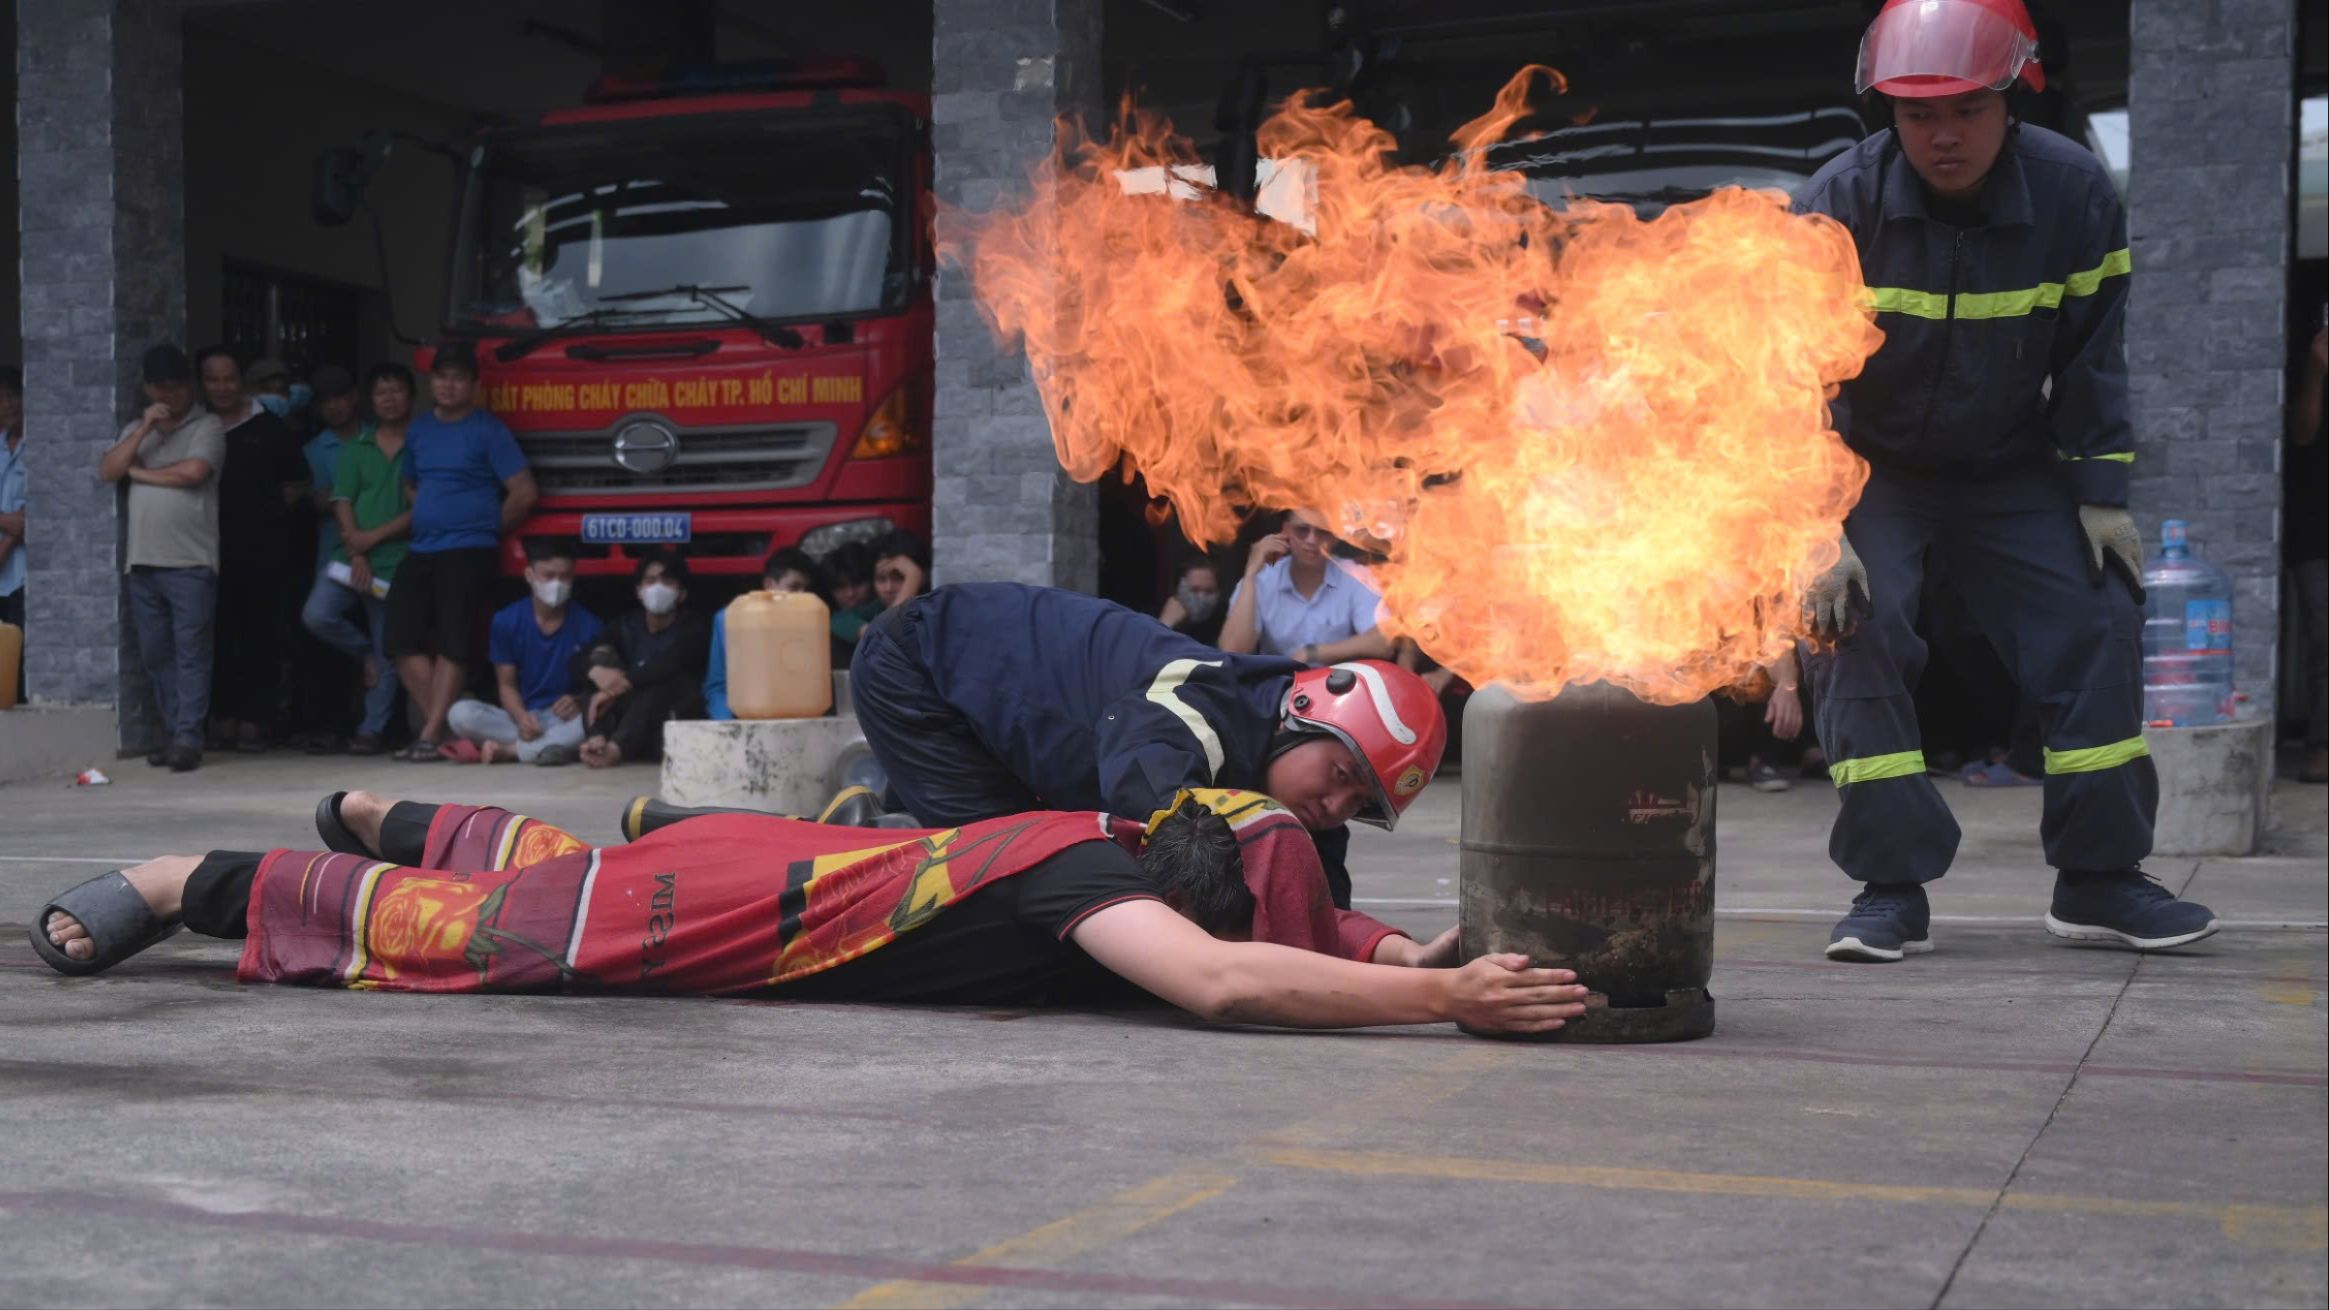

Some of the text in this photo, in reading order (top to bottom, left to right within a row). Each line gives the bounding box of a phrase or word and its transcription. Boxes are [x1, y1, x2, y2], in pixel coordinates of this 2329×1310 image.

[579, 379, 621, 410] CHÁY
[674, 376, 719, 407] CHÁY
[721, 379, 745, 406] TP.
[813, 376, 862, 403] MINH
